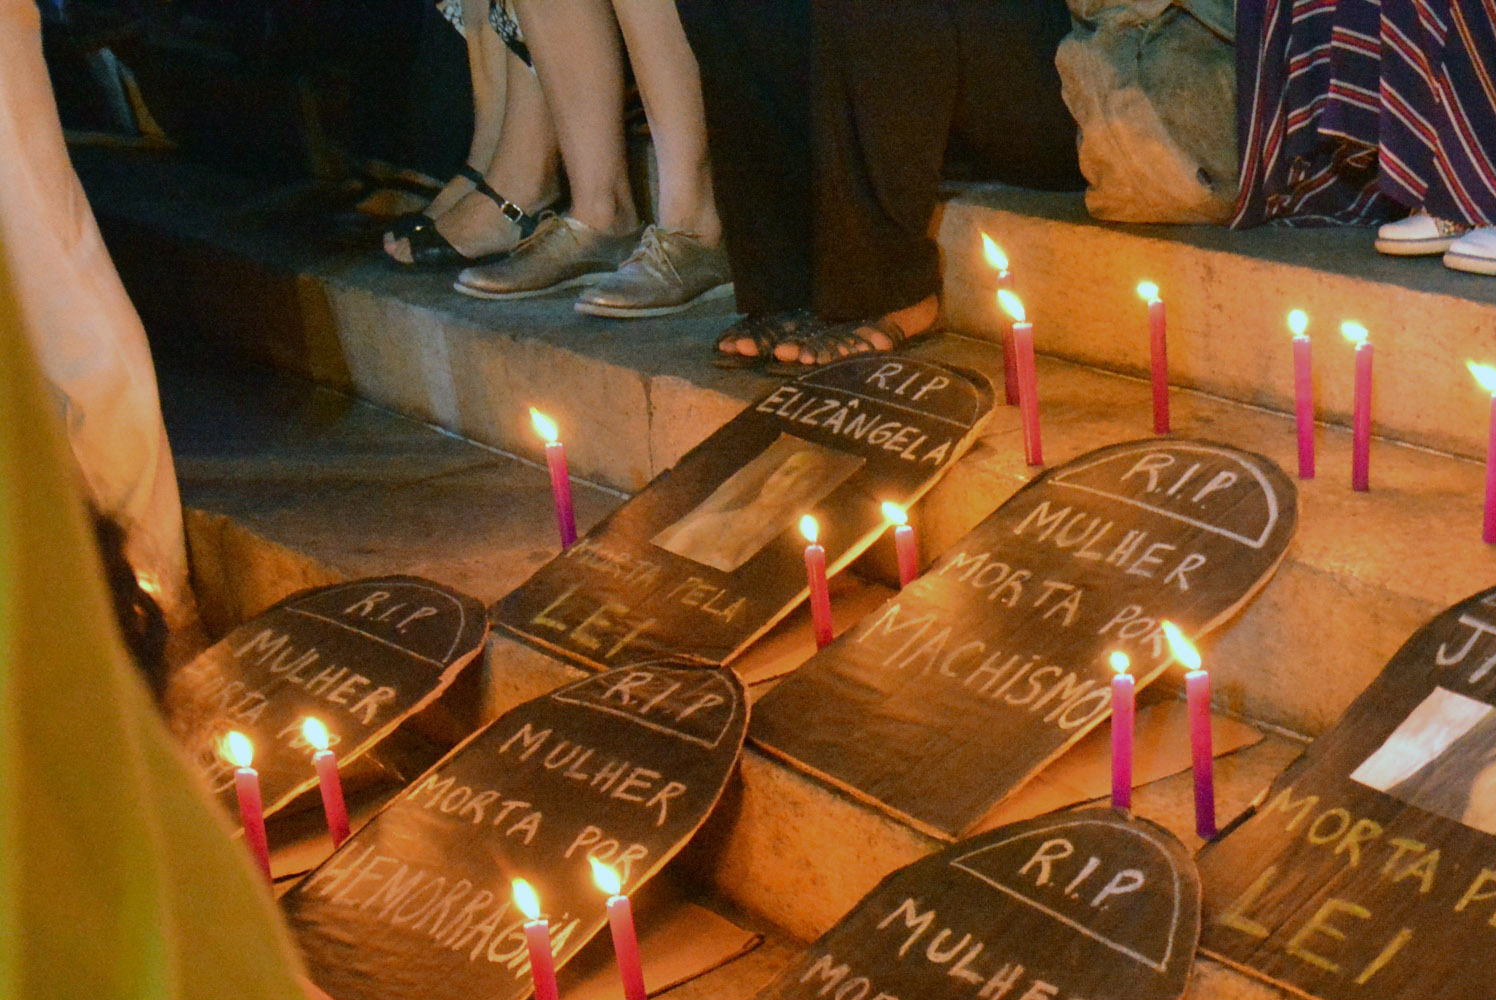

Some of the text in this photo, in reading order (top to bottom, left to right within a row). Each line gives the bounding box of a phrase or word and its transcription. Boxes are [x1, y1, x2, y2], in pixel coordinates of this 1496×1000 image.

[756, 385, 953, 467] ELIZÂNGELA
[938, 551, 1084, 627] MORTA
[1013, 501, 1207, 592] MULHER
[531, 583, 658, 659] LEI
[666, 576, 748, 625] PELA
[233, 627, 397, 726] MULHER
[499, 722, 687, 827] MULHER
[406, 773, 649, 887] MORTA POR
[1269, 788, 1442, 893] MORTA
[1215, 866, 1413, 985] LEI
